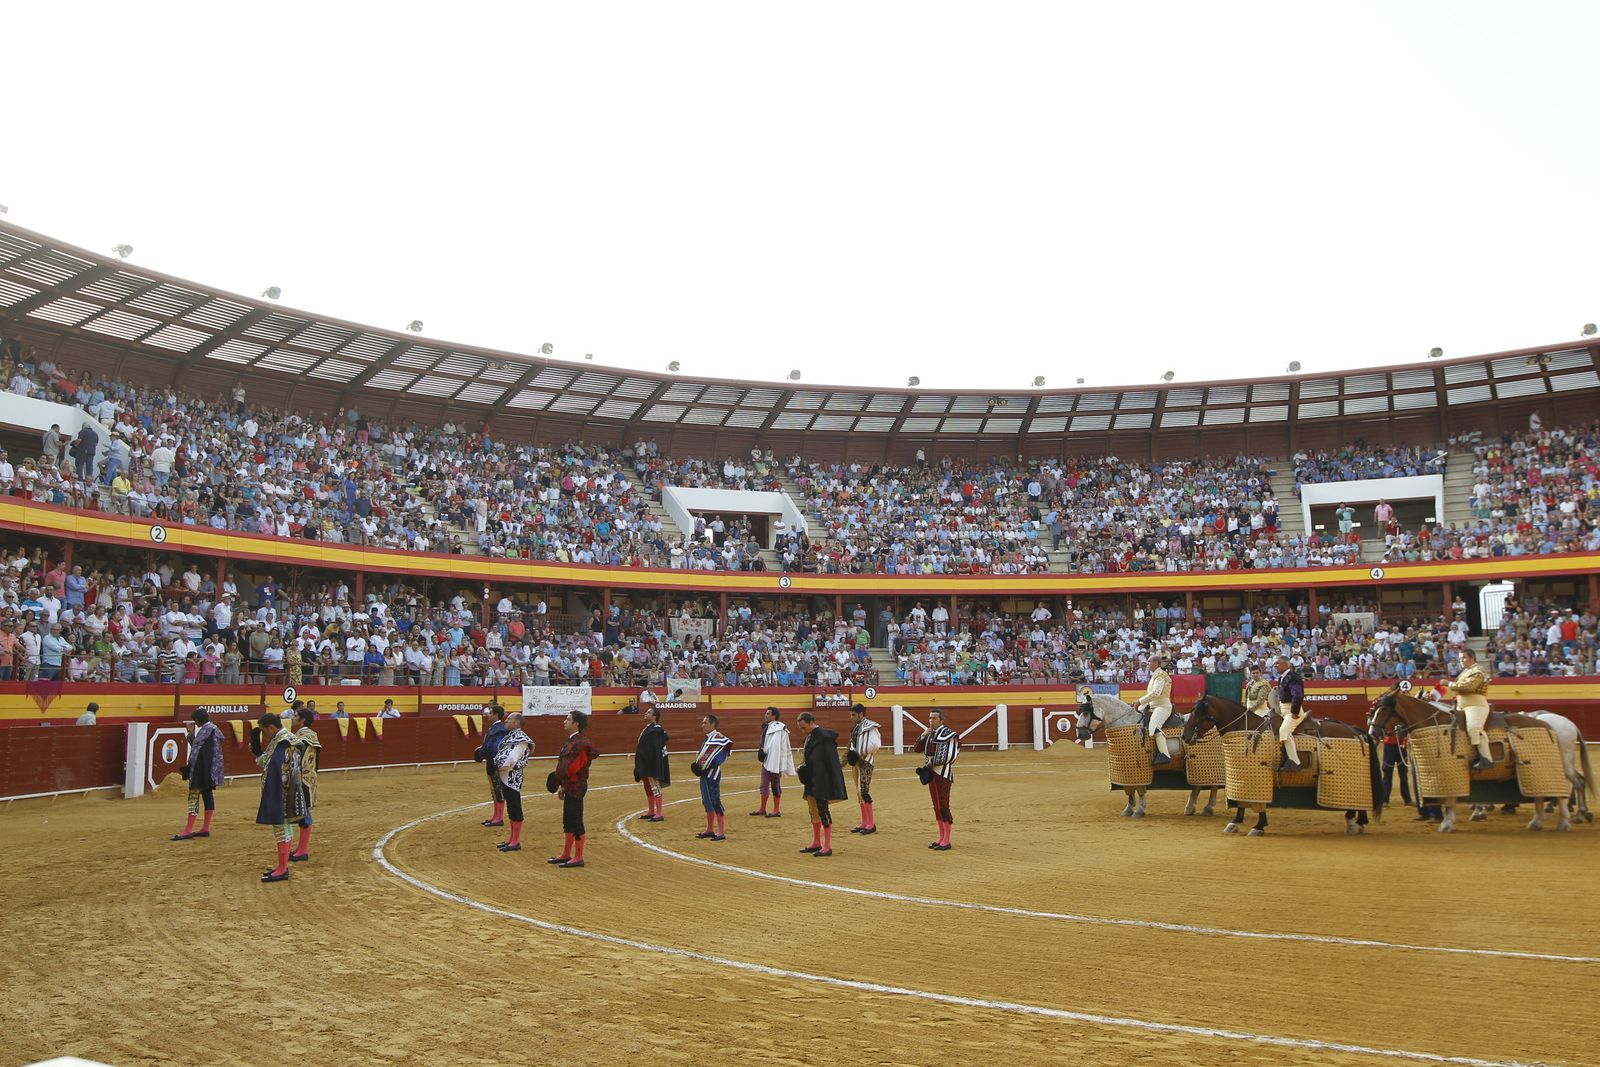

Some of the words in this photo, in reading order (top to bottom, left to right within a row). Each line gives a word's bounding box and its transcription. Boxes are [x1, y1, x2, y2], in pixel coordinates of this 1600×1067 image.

[154, 527, 162, 540] 2
[286, 688, 294, 701] 2
[867, 688, 874, 698] 3
